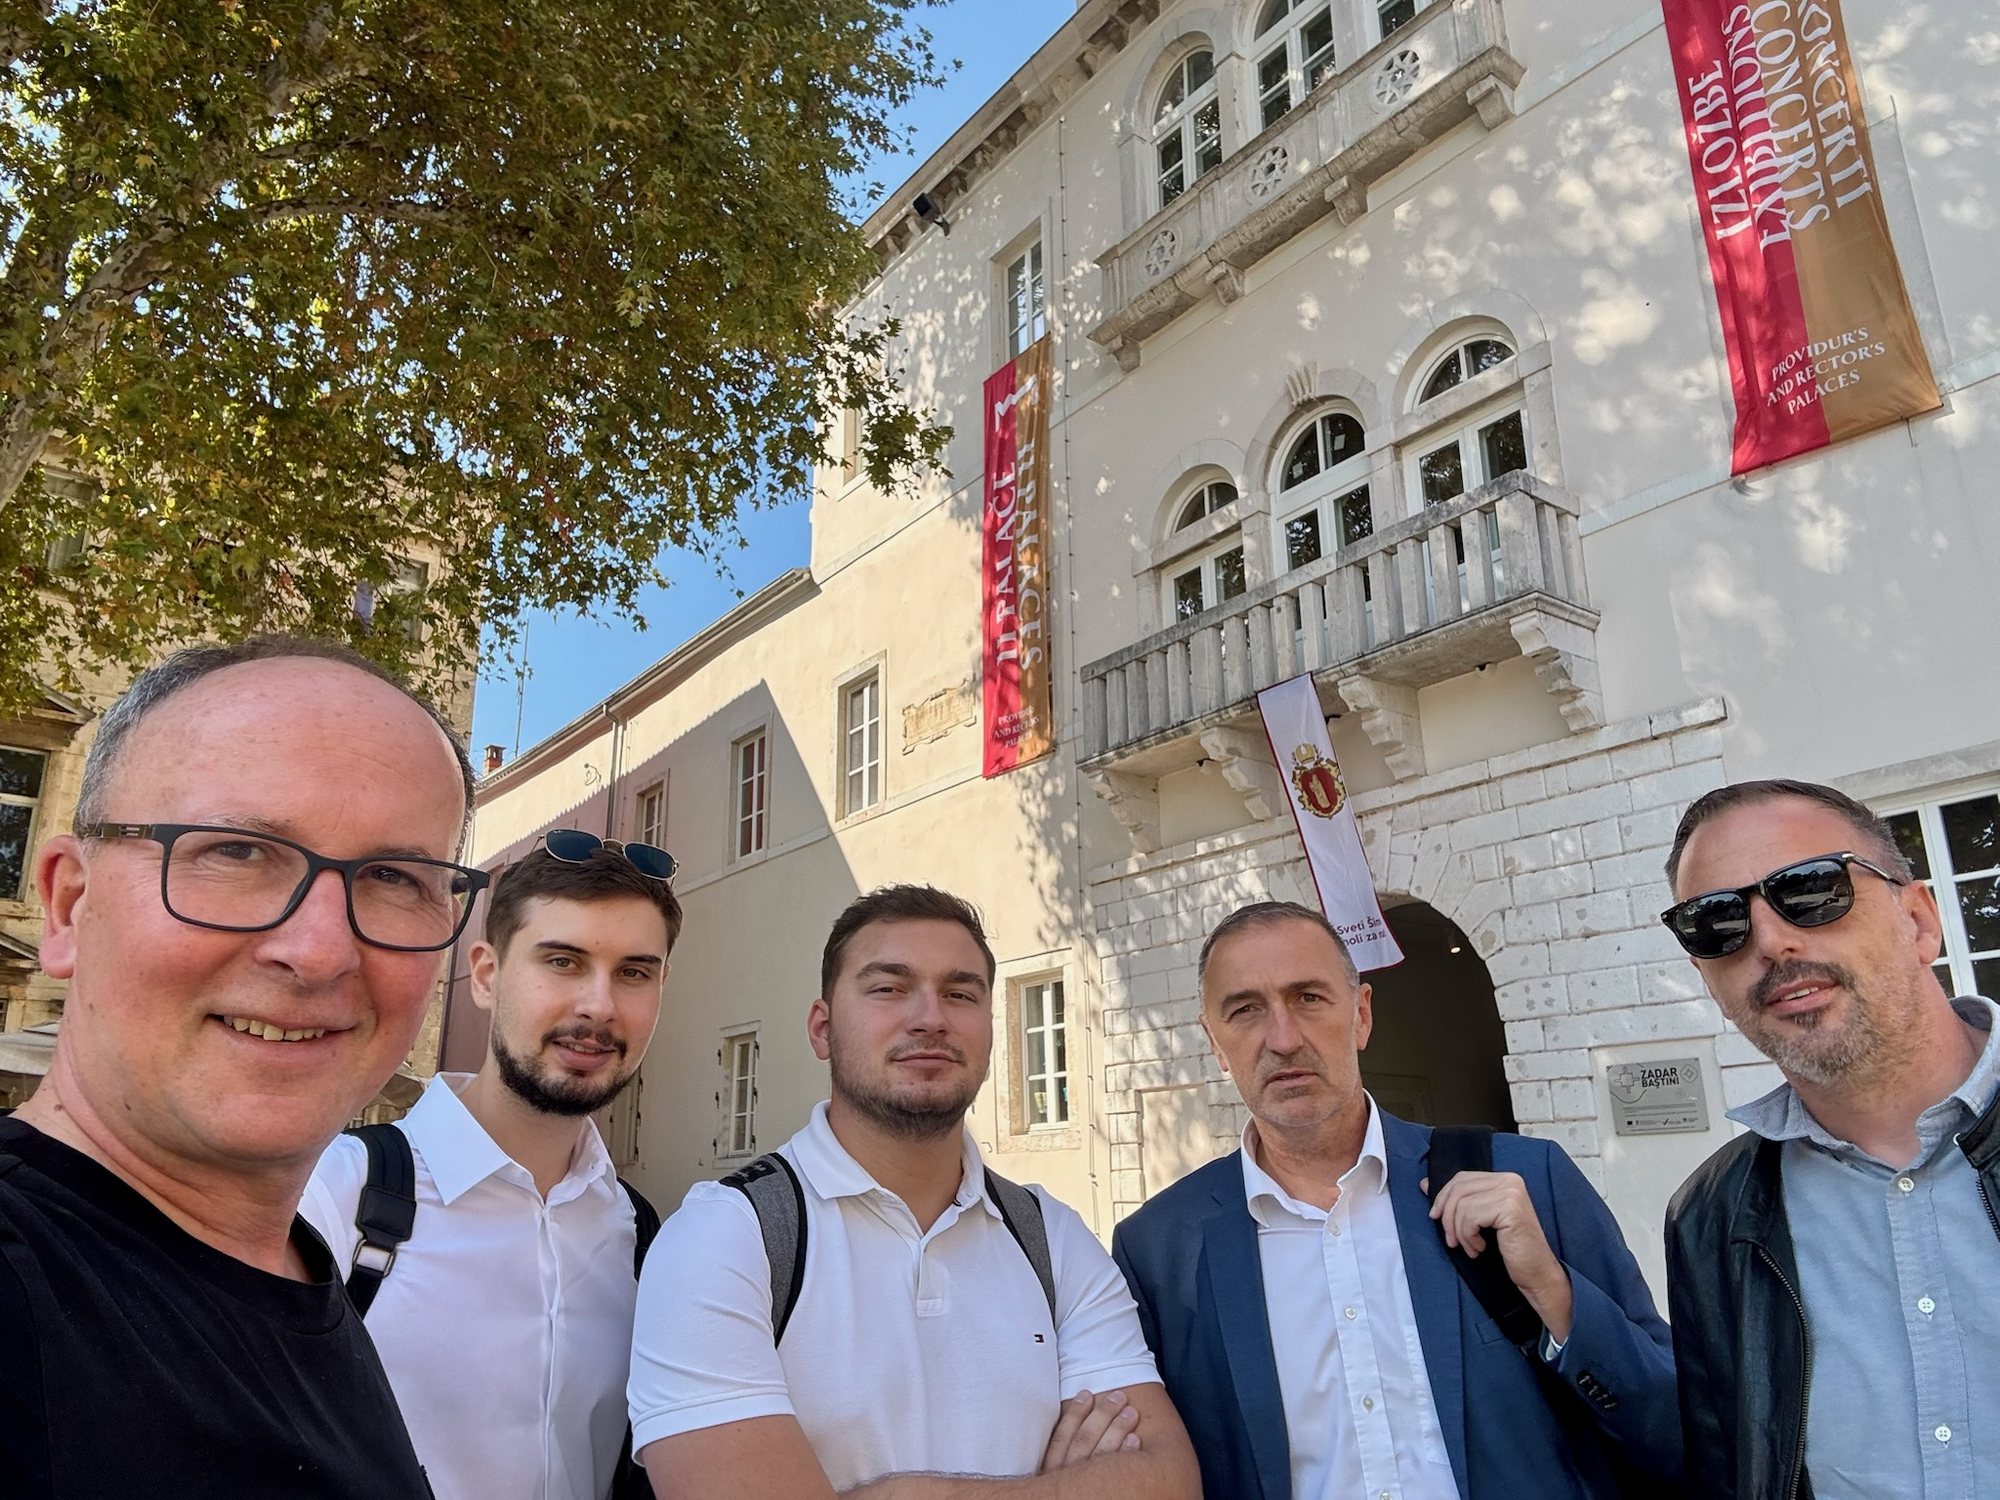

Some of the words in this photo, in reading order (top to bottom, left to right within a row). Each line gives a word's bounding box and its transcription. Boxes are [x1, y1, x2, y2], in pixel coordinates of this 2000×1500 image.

[1750, 0, 1831, 231] CONCERTS
[1689, 60, 1752, 240] IZLOŽBE
[1767, 379, 1794, 407] AND
[1795, 341, 1886, 387] RECTOR'S
[1772, 327, 1869, 382] PROVIDUR'S
[1787, 369, 1860, 415] PALACES
[1337, 920, 1365, 935] Sveti
[1366, 932, 1377, 942] za
[1641, 1068, 1678, 1079] ZADAR
